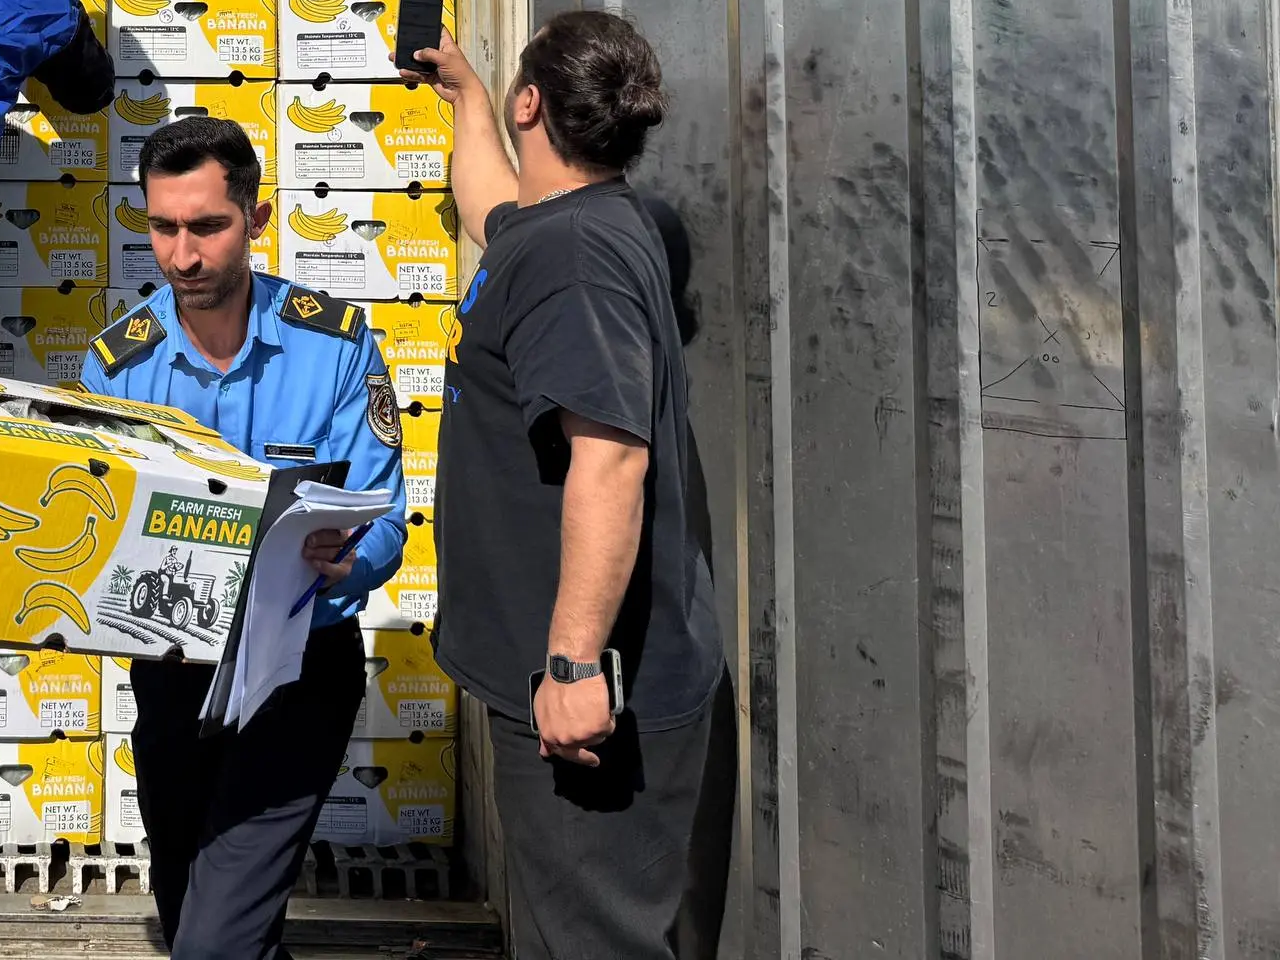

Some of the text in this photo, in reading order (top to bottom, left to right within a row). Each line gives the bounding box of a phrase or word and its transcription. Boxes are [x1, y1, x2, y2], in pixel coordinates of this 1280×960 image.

[207, 18, 267, 31] BANANA
[385, 133, 446, 147] BANANA
[410, 162, 426, 170] 13.5
[410, 170, 427, 178] 13.0
[39, 232, 100, 245] BANANA
[386, 245, 449, 258] BANANA
[63, 261, 79, 269] 13.5
[63, 269, 93, 277] 13.0 KG
[412, 274, 443, 282] 13.5 KG
[412, 282, 428, 290] 13.0
[385, 348, 445, 359] BANANA
[170, 499, 242, 521] FARM FRESH
[148, 510, 252, 546] BANANA
[29, 680, 92, 694] BANANA
[388, 681, 449, 693] BANANA
[41, 702, 57, 710] NET
[72, 710, 85, 718] KG
[72, 719, 84, 727] KG
[32, 781, 95, 798] BANANA
[45, 805, 61, 813] NET
[58, 812, 89, 822] 13.5 KG
[58, 822, 89, 831] 13.0 KG
